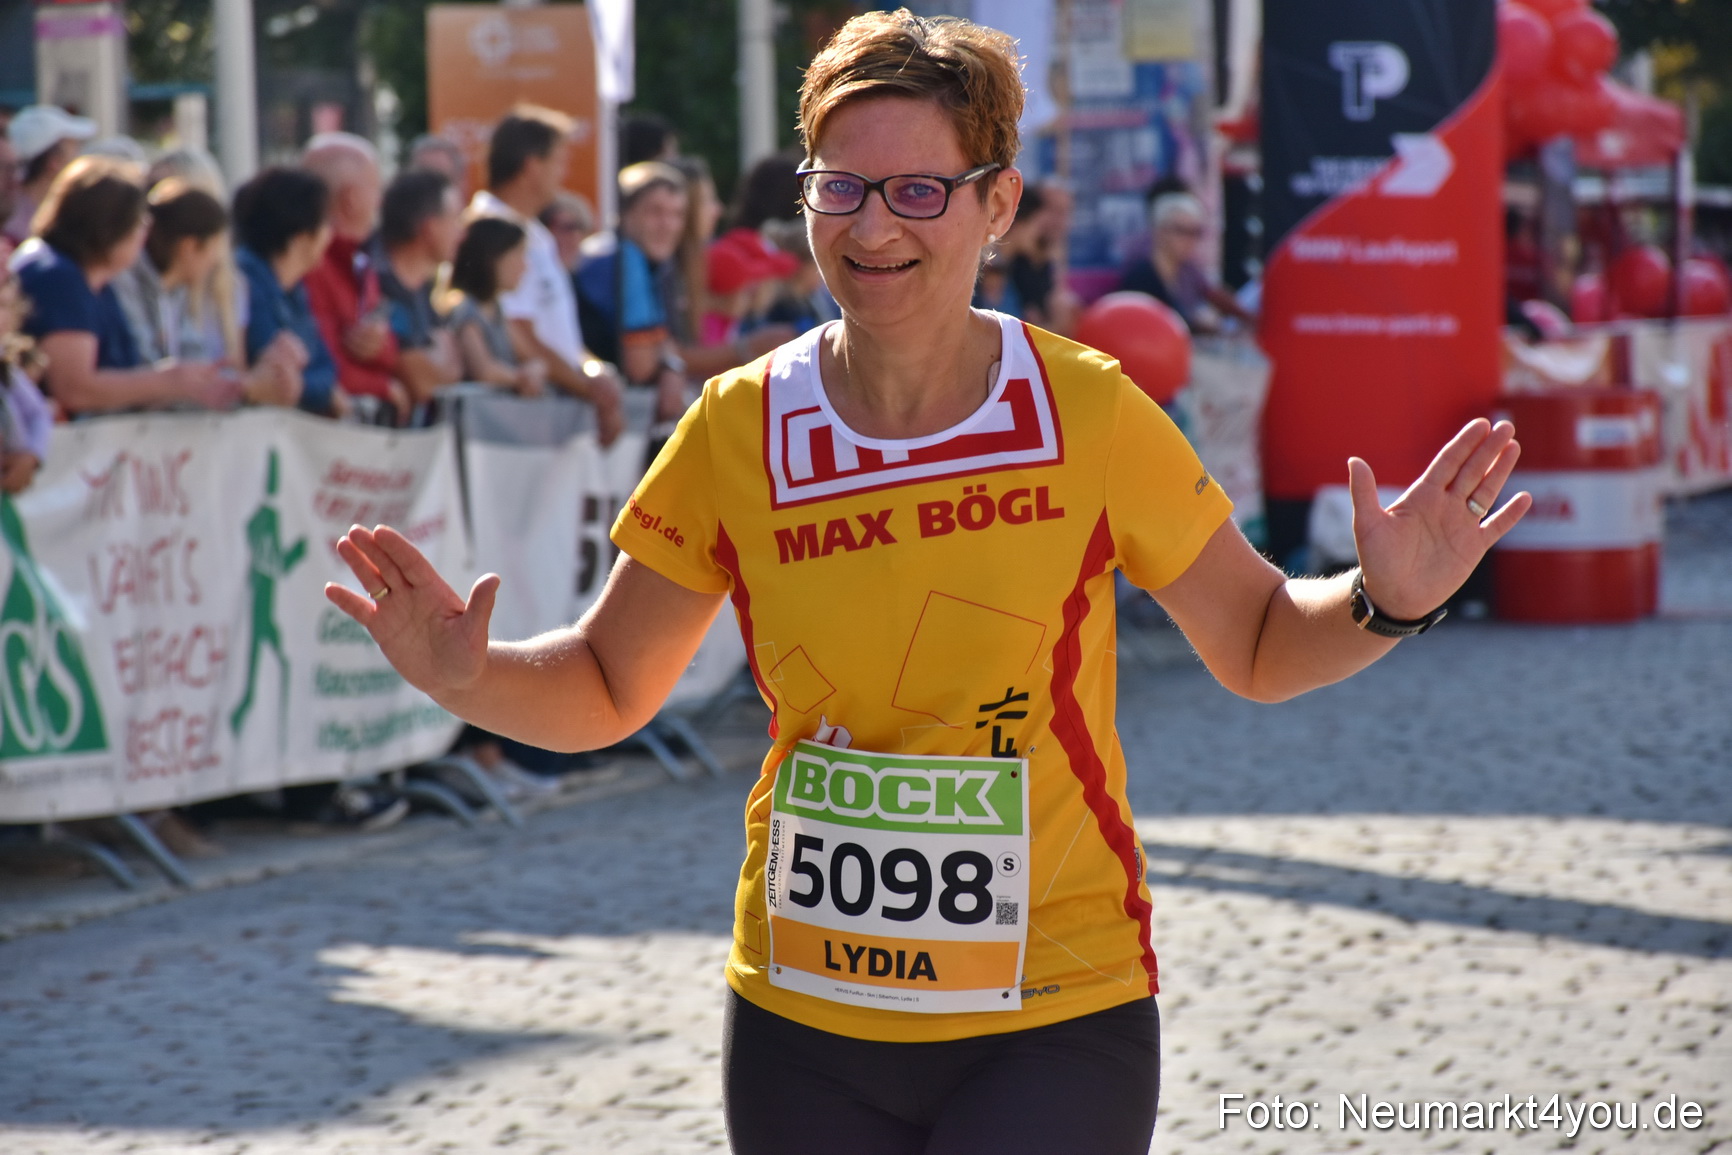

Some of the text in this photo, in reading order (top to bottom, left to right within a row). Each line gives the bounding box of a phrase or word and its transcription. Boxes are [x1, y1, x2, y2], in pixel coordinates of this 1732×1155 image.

[629, 496, 685, 548] oegl.de
[773, 484, 1065, 564] MAX BÖGL
[787, 753, 1002, 824] BOCK
[788, 833, 994, 925] 5098
[1002, 857, 1015, 872] S
[824, 940, 938, 982] LYDIA
